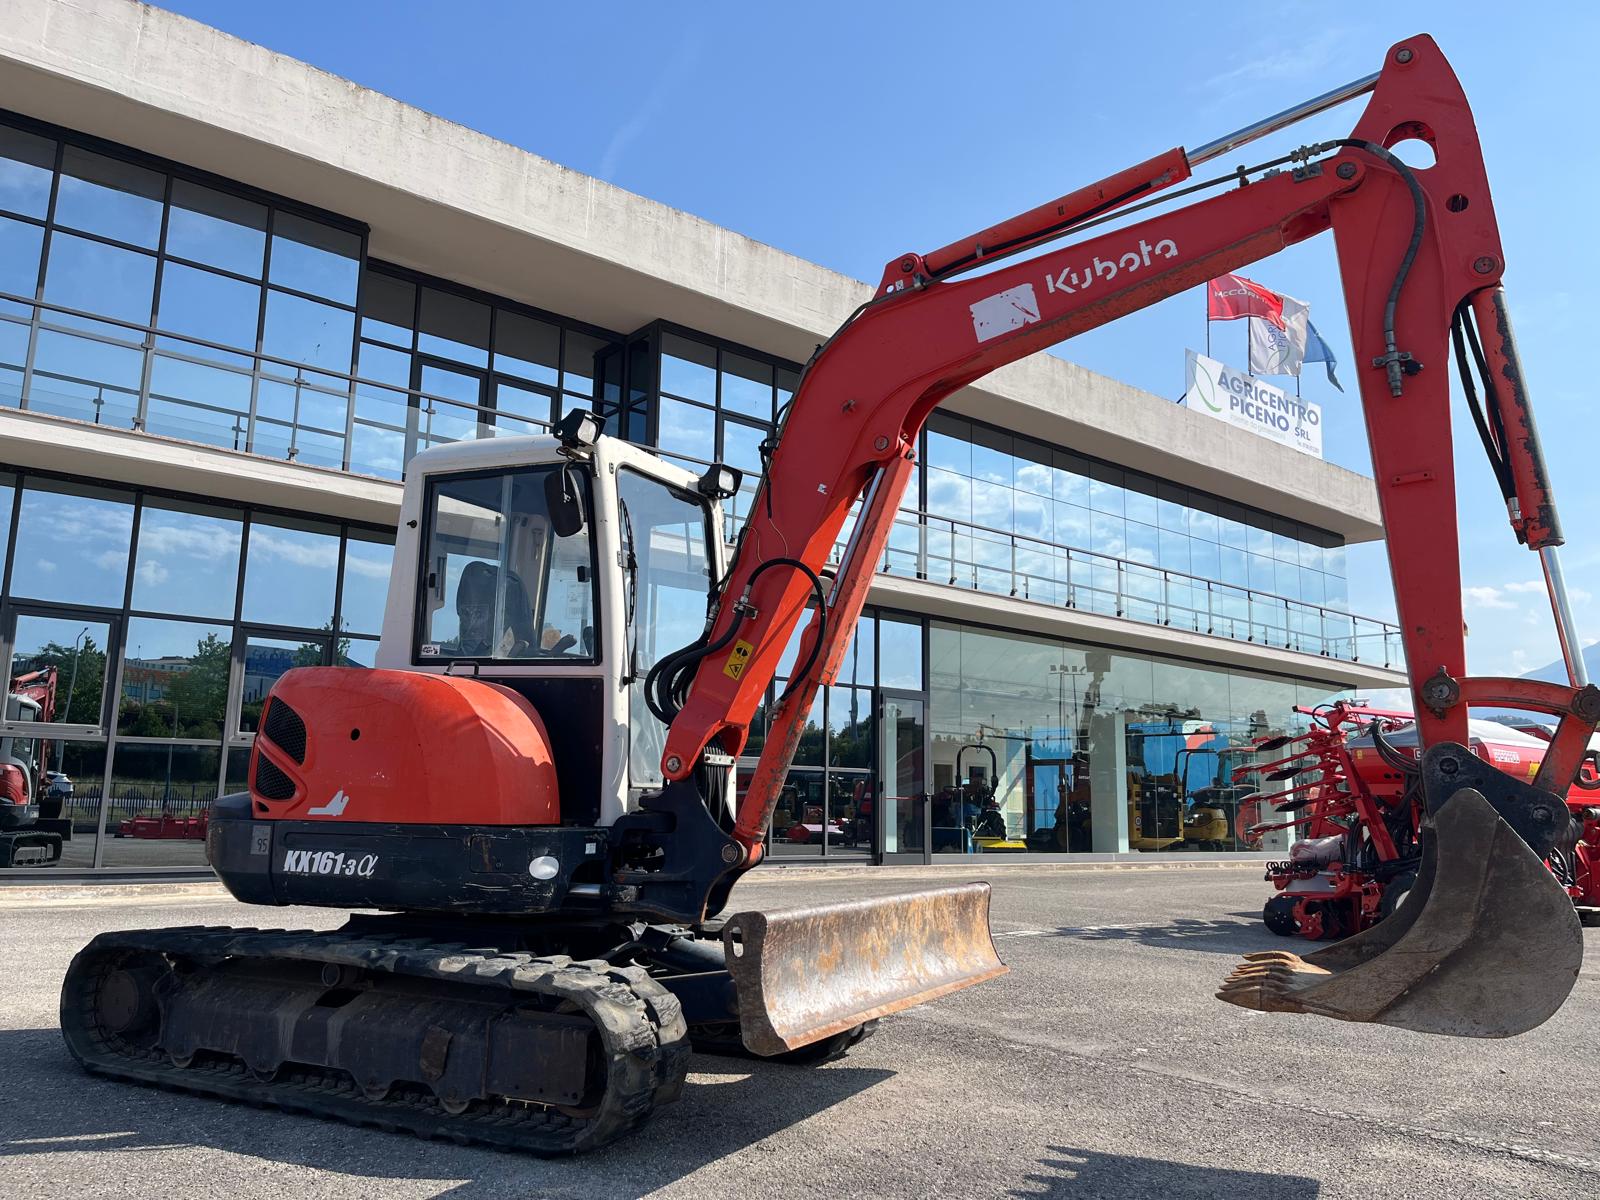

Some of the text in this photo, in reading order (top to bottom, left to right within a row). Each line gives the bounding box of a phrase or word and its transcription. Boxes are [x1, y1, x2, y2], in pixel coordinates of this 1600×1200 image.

[1045, 239, 1179, 294] Kubota
[1218, 372, 1319, 426] AGRICENTRO
[1229, 394, 1290, 432] PICENO
[1294, 426, 1311, 441] SRL
[257, 838, 268, 853] 95
